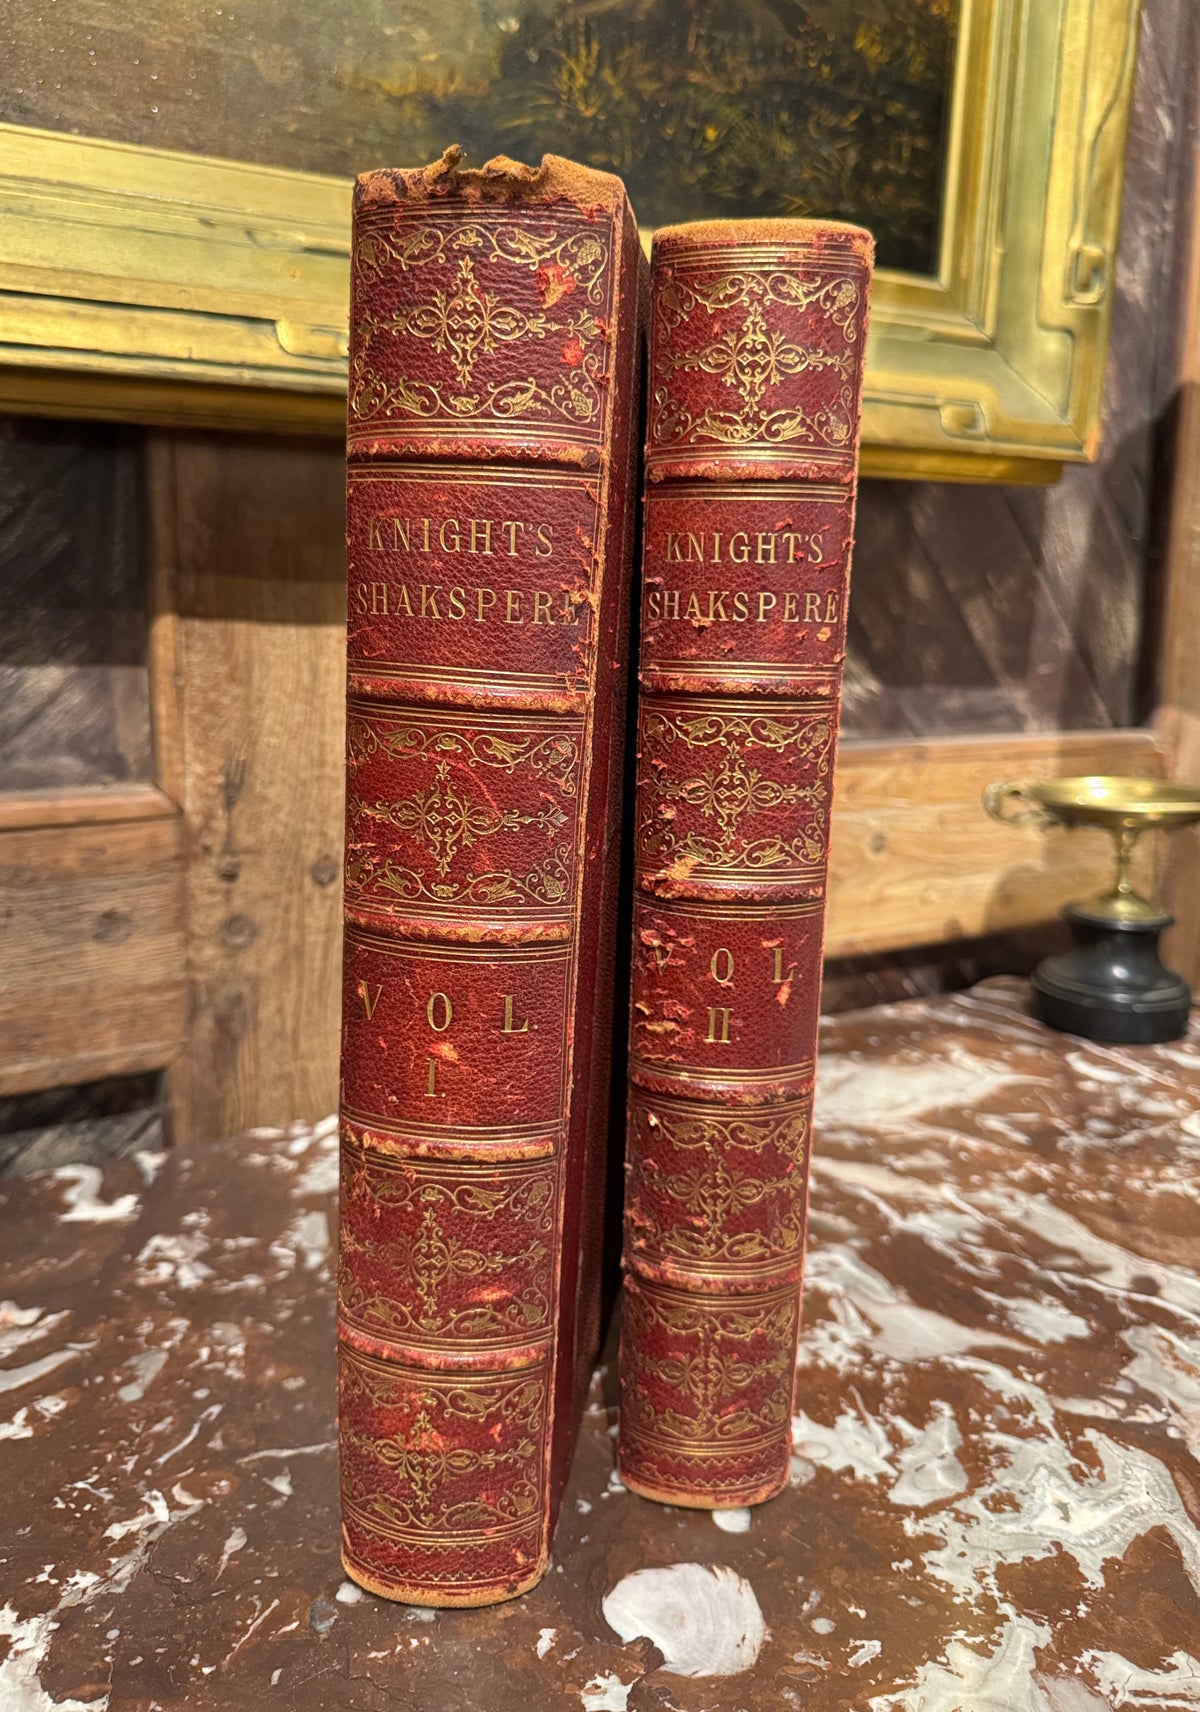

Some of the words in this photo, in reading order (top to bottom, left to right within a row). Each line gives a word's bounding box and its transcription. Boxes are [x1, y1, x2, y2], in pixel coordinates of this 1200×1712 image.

[367, 517, 554, 557] KNIGHT'S
[664, 531, 823, 564] KNIGHT'S
[647, 589, 839, 623] SHAKSPERE
